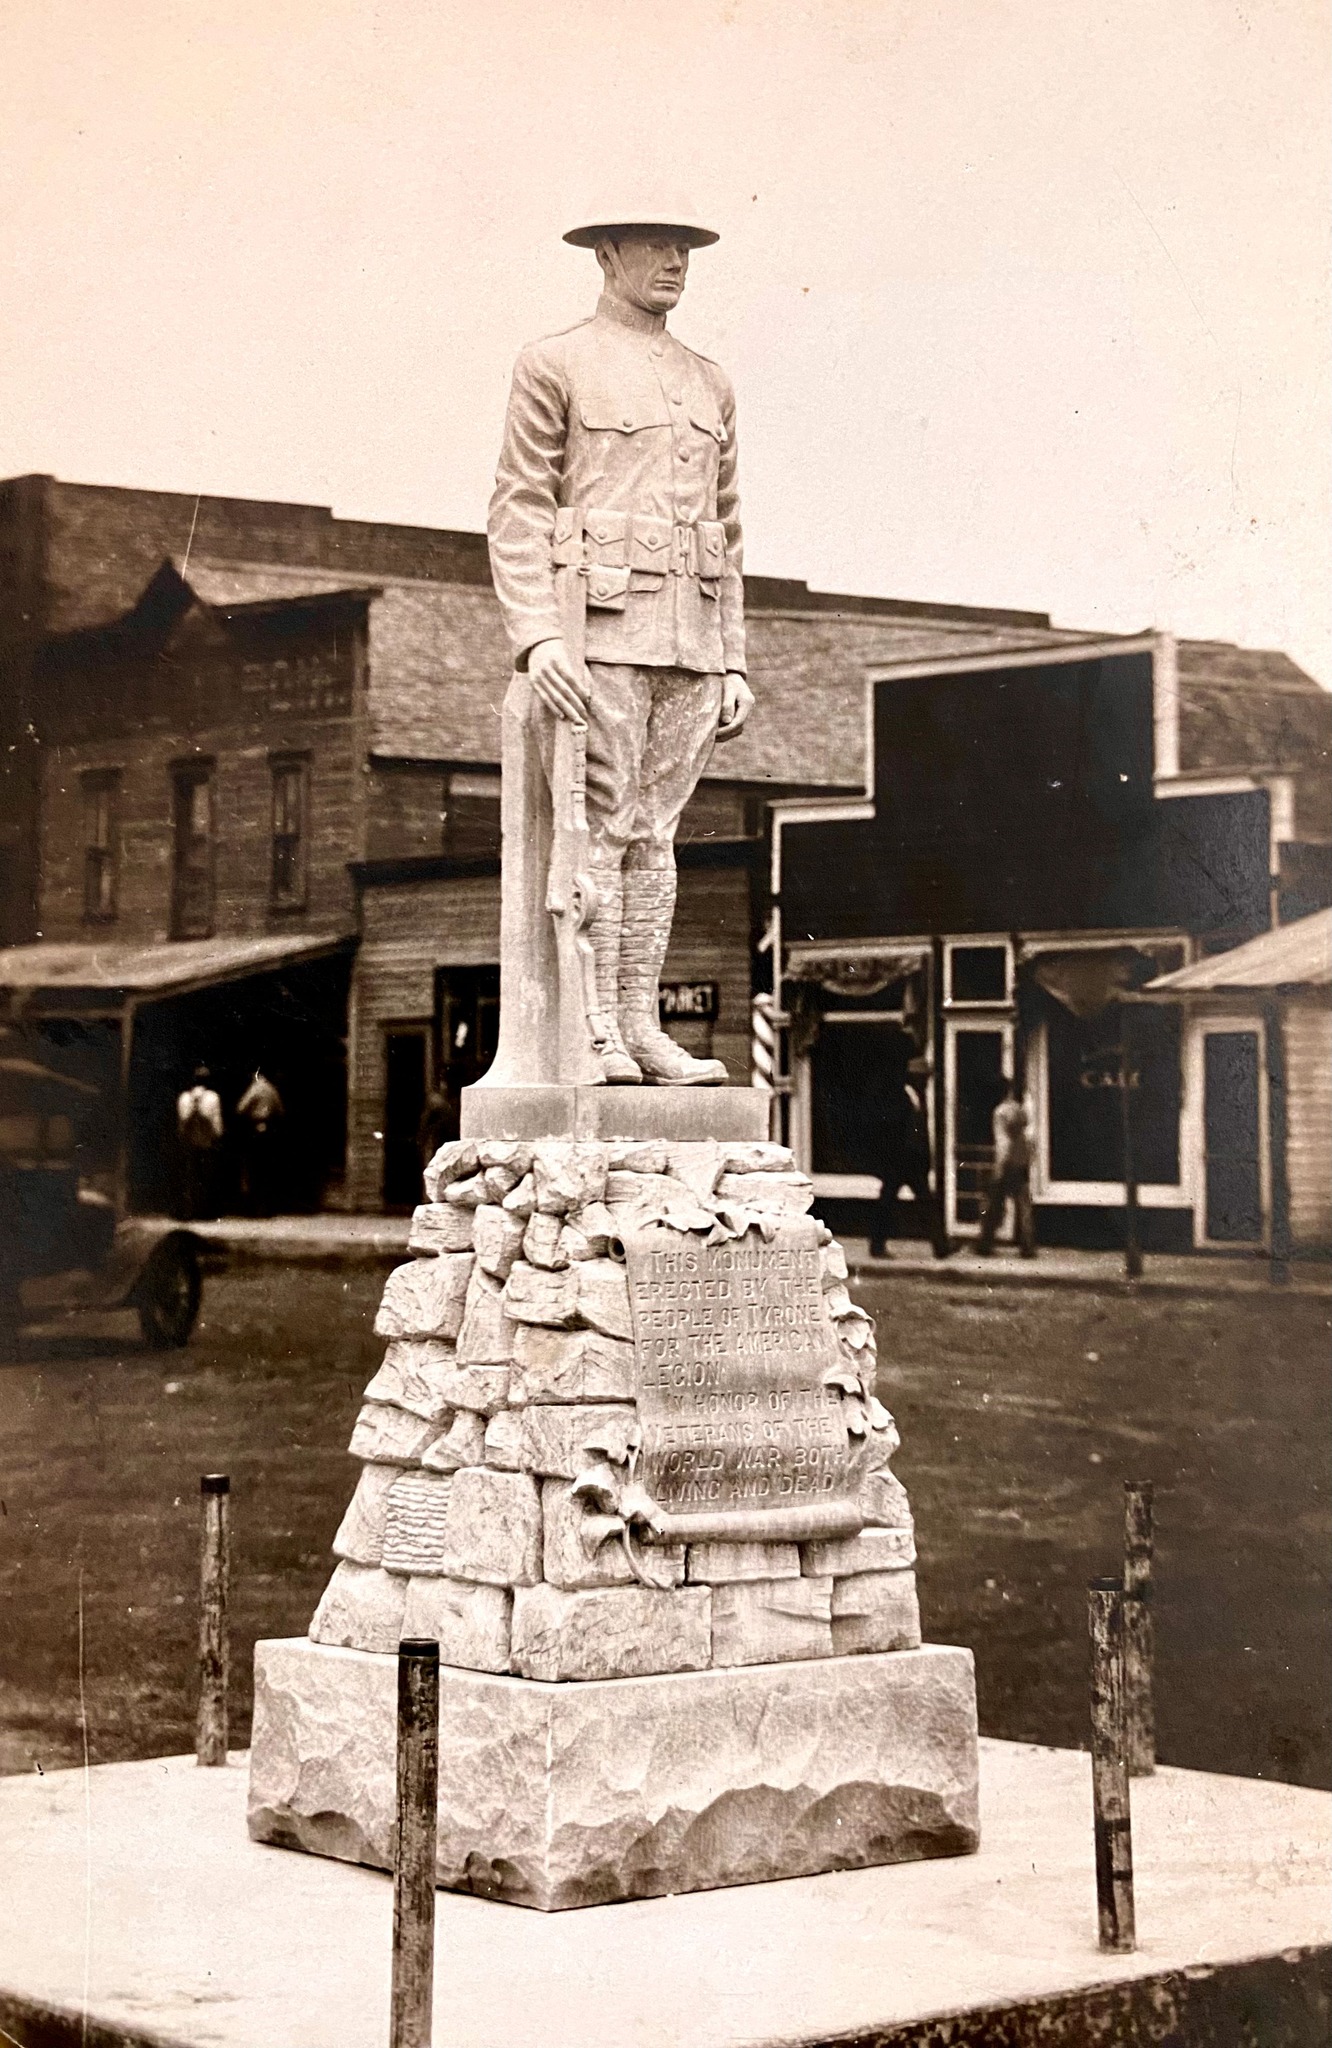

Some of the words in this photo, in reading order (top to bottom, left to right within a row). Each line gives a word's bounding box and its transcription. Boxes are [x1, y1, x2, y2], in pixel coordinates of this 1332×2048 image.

[651, 1251, 698, 1273] THIS
[708, 1250, 817, 1272] MONUMENT
[636, 1280, 732, 1299] ERECTED
[743, 1278, 768, 1298] BY
[779, 1277, 819, 1297] THE
[639, 1308, 714, 1328] PEOPLE
[721, 1307, 742, 1327] OF
[748, 1303, 821, 1327] TYRONE
[641, 1338, 681, 1358] FOR
[689, 1332, 729, 1356] THE
[736, 1331, 826, 1355] AMERICAN
[642, 1361, 719, 1388] LEGION
[694, 1391, 758, 1414] HONOR
[768, 1390, 789, 1411] OF
[799, 1388, 838, 1409] THE
[648, 1424, 753, 1447] VETERANS
[762, 1420, 784, 1440] OF
[793, 1417, 833, 1438] THE
[652, 1449, 726, 1475] WORLD
[737, 1447, 782, 1470] WAR
[794, 1445, 845, 1467] BOTH
[655, 1479, 721, 1504] LIVING
[729, 1477, 770, 1497] AND
[779, 1473, 835, 1494] DEAD
